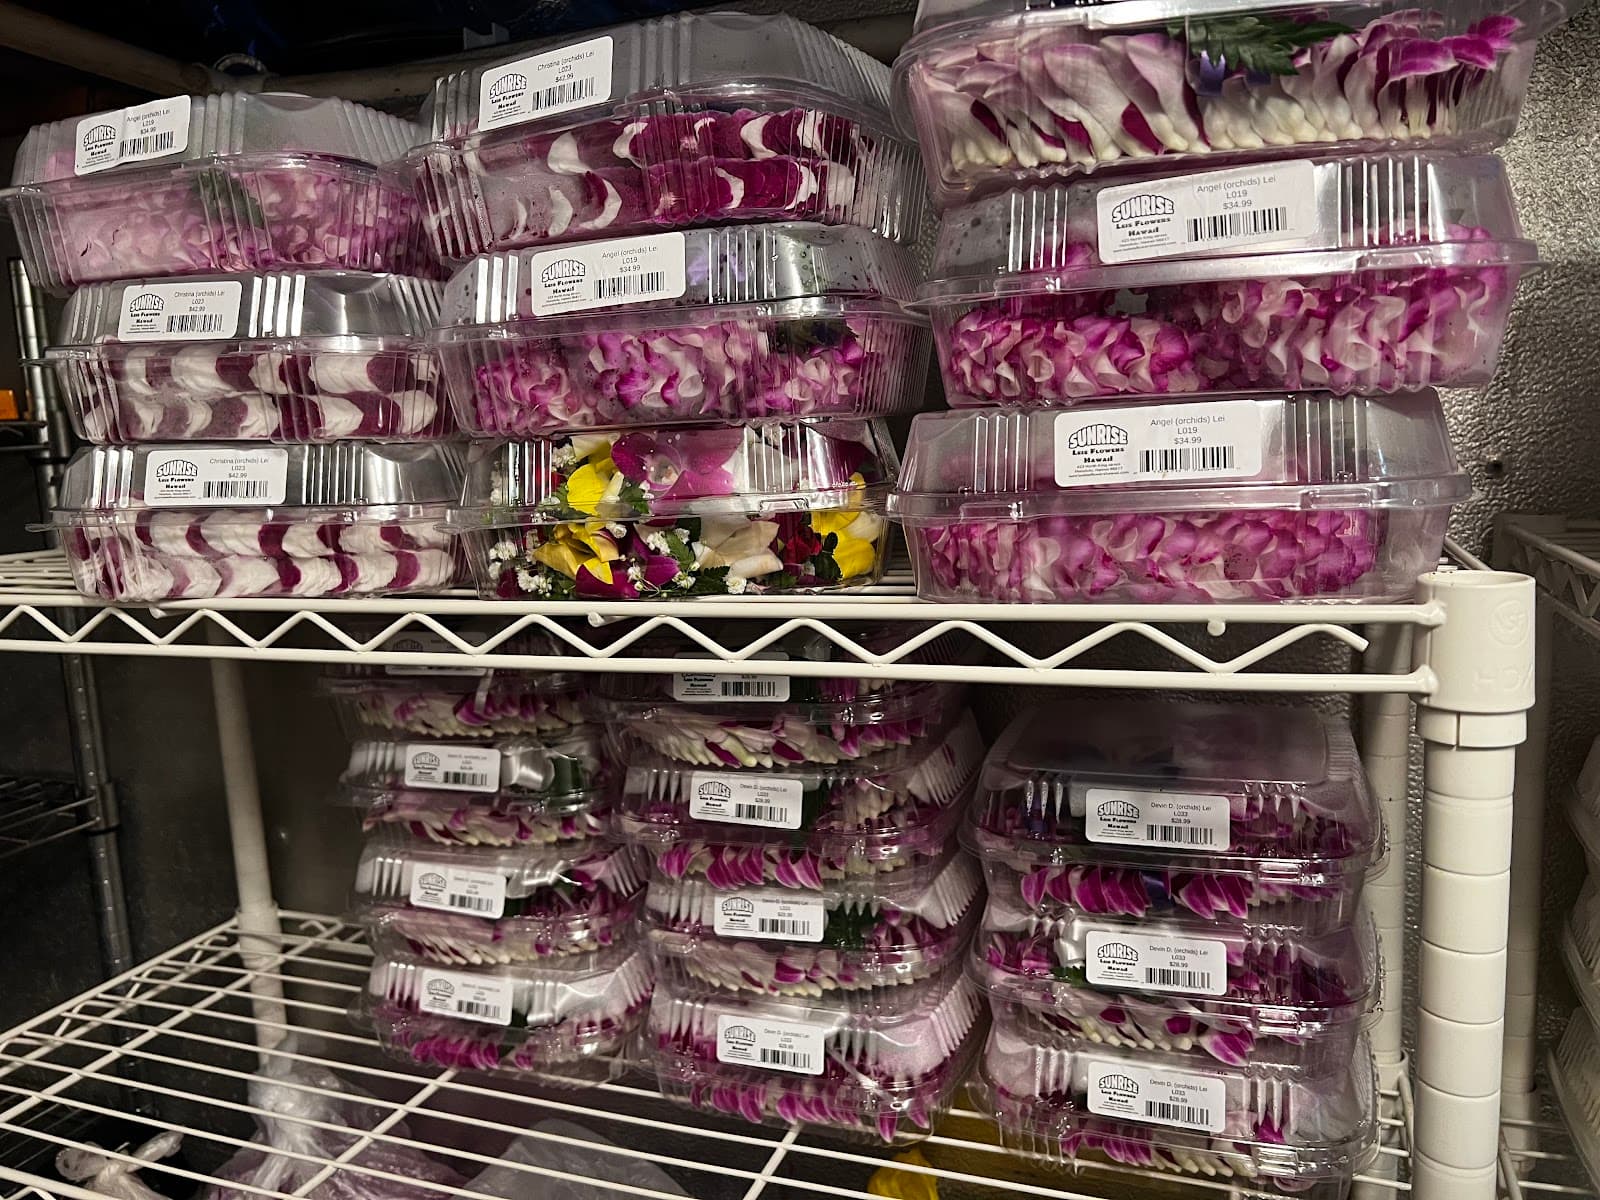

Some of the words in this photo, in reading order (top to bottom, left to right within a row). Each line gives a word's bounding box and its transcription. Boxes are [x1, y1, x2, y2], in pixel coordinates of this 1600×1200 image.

[537, 60, 560, 71] Christina
[562, 53, 584, 65] (orchids)
[490, 73, 527, 99] SUNRISE
[83, 125, 116, 146] SUNRISE
[1197, 183, 1220, 193] Angel
[1223, 177, 1260, 190] (orchids)
[1226, 190, 1247, 199] L019
[1112, 195, 1174, 223] SUNRISE
[1223, 200, 1252, 209] $34.99
[602, 249, 619, 258] Angel
[621, 247, 647, 256] (orchids)
[542, 259, 585, 282] SUNRISE
[130, 294, 164, 312] SUNRISE
[1150, 418, 1173, 426] Angel
[1176, 416, 1210, 425] (orchids)
[1069, 424, 1128, 449] SUNRISE
[157, 460, 198, 477] SUNRISE
[699, 781, 731, 798] SUNRISE
[1097, 800, 1139, 819] SUNRISE
[1097, 943, 1138, 961] SUNRISE
[1099, 1075, 1138, 1094] SUNRISE
